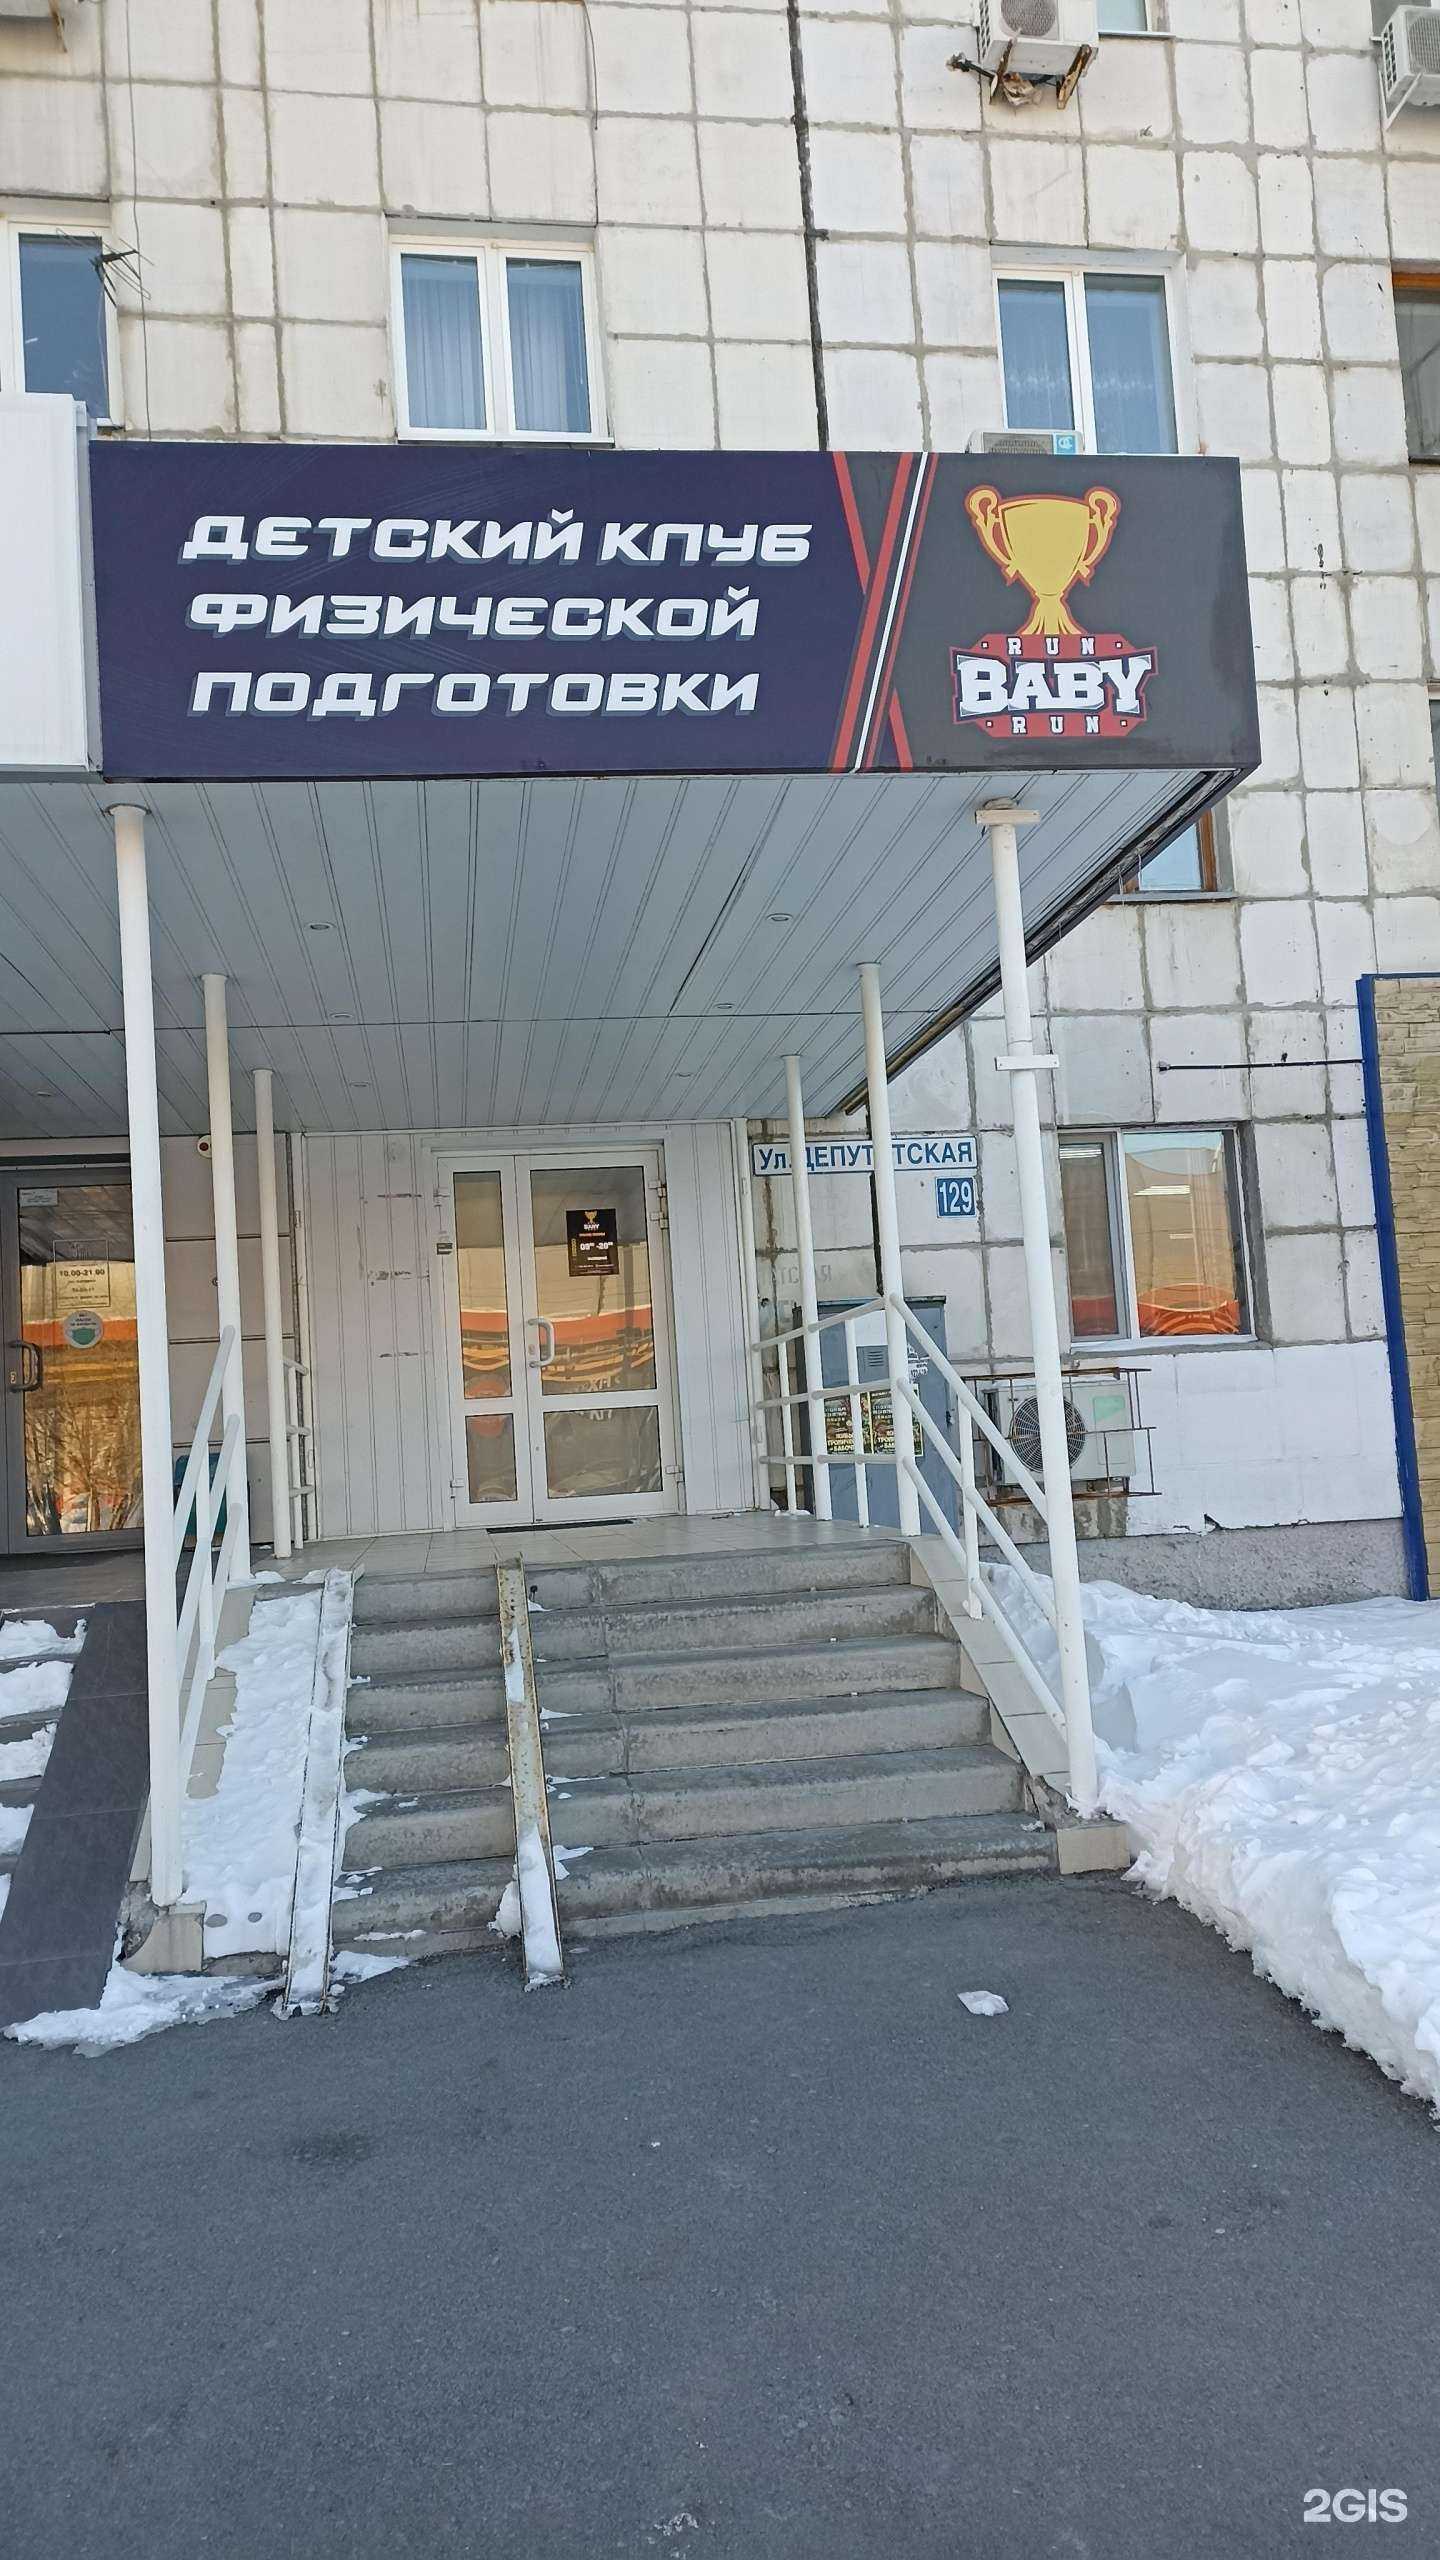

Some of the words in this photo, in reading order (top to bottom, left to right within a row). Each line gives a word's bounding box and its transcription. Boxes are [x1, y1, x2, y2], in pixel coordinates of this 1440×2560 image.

[181, 509, 584, 562] ДЕТСКИЙ
[600, 522, 812, 563] КЛУБ
[190, 586, 760, 637] ФИЗИЧЕСКОЙ
[1007, 636, 1096, 655] RUN
[191, 672, 760, 717] ПОДГОТОВКИ
[956, 654, 1152, 717] BABY
[1011, 715, 1100, 735] RUN
[803, 1141, 972, 1172] ДЕПУТТСКАЯ
[938, 1180, 973, 1213] 129
